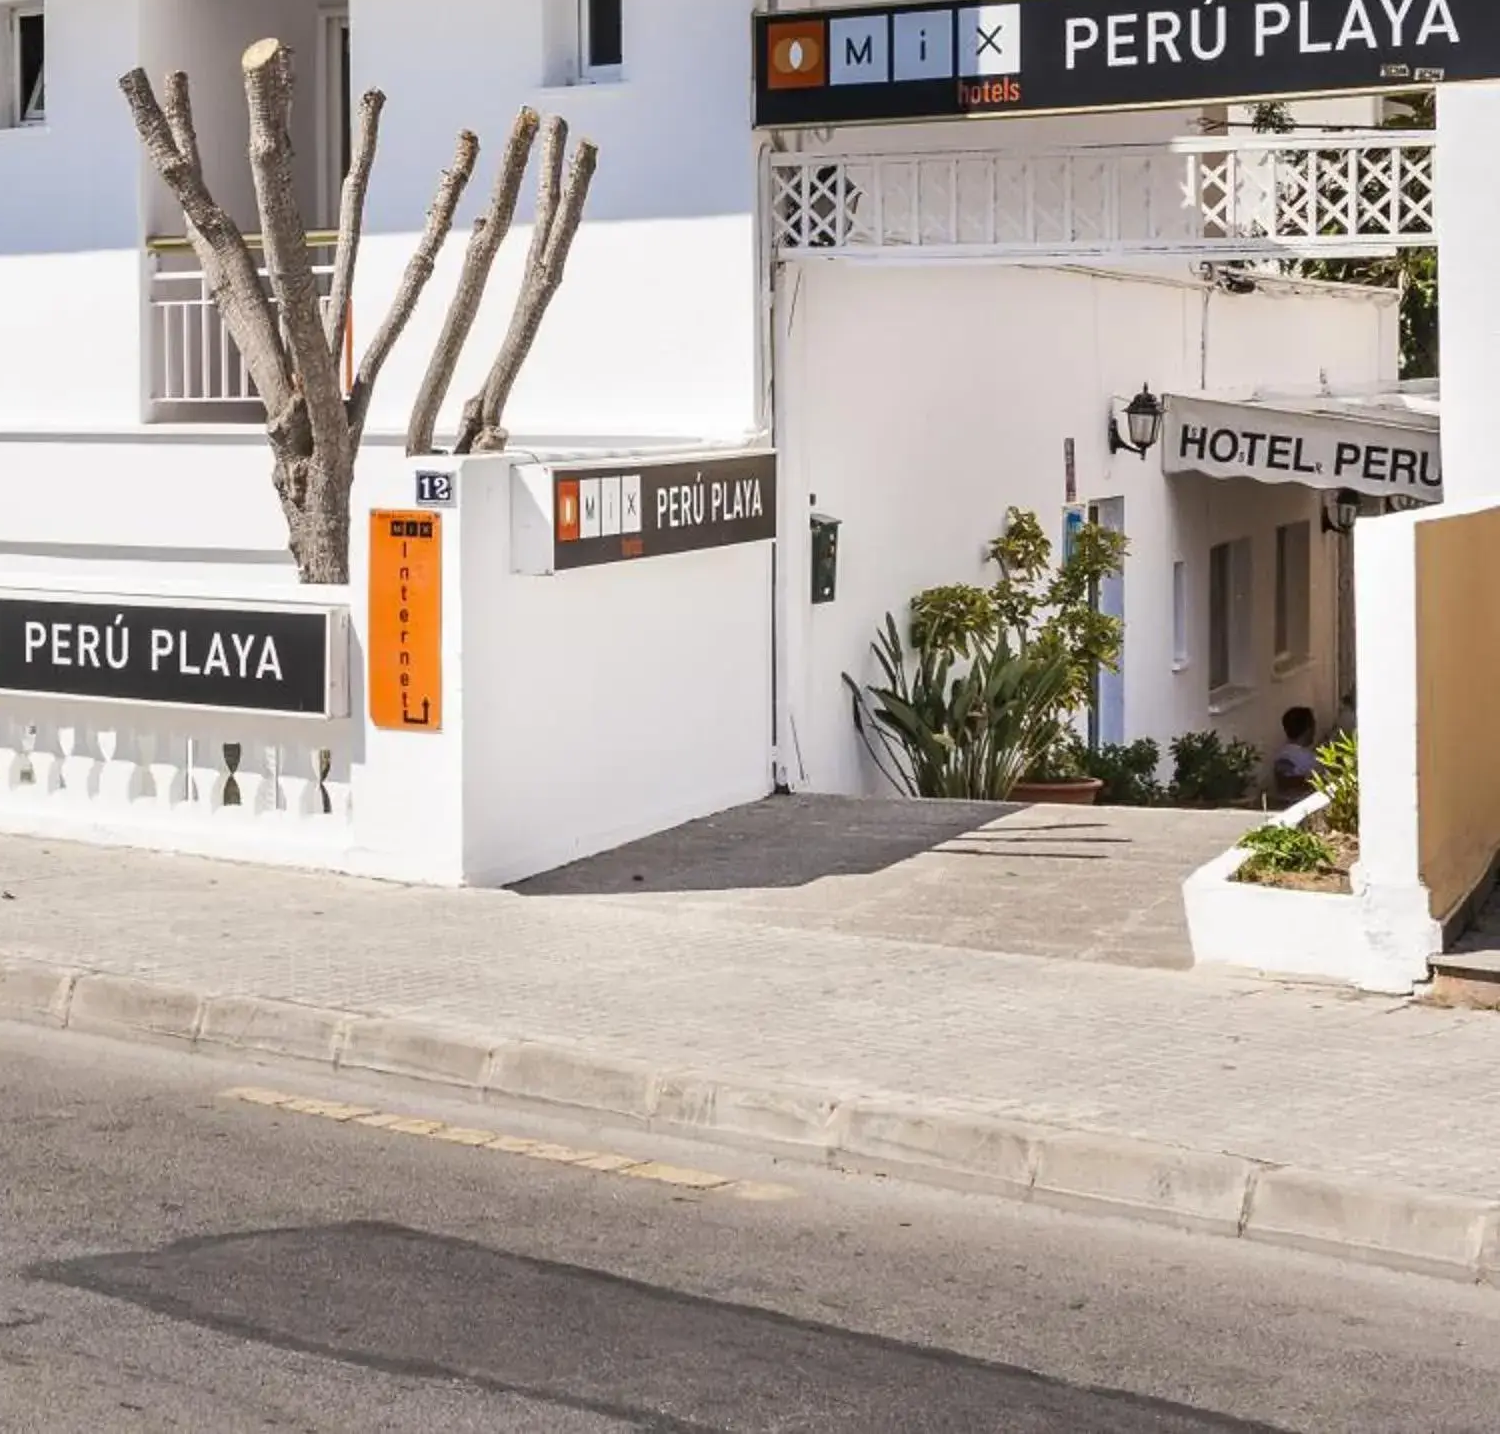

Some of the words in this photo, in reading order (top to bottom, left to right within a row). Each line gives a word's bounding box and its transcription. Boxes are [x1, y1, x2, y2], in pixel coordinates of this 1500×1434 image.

[957, 75, 1021, 104] hotels
[1179, 424, 1315, 473] HOTEL
[1334, 442, 1442, 487] PERU
[421, 477, 450, 499] 12
[656, 471, 705, 529] PERÚ
[711, 477, 763, 522] PLAYA
[24, 613, 130, 669] PERÚ
[150, 629, 284, 681] PLAYA
